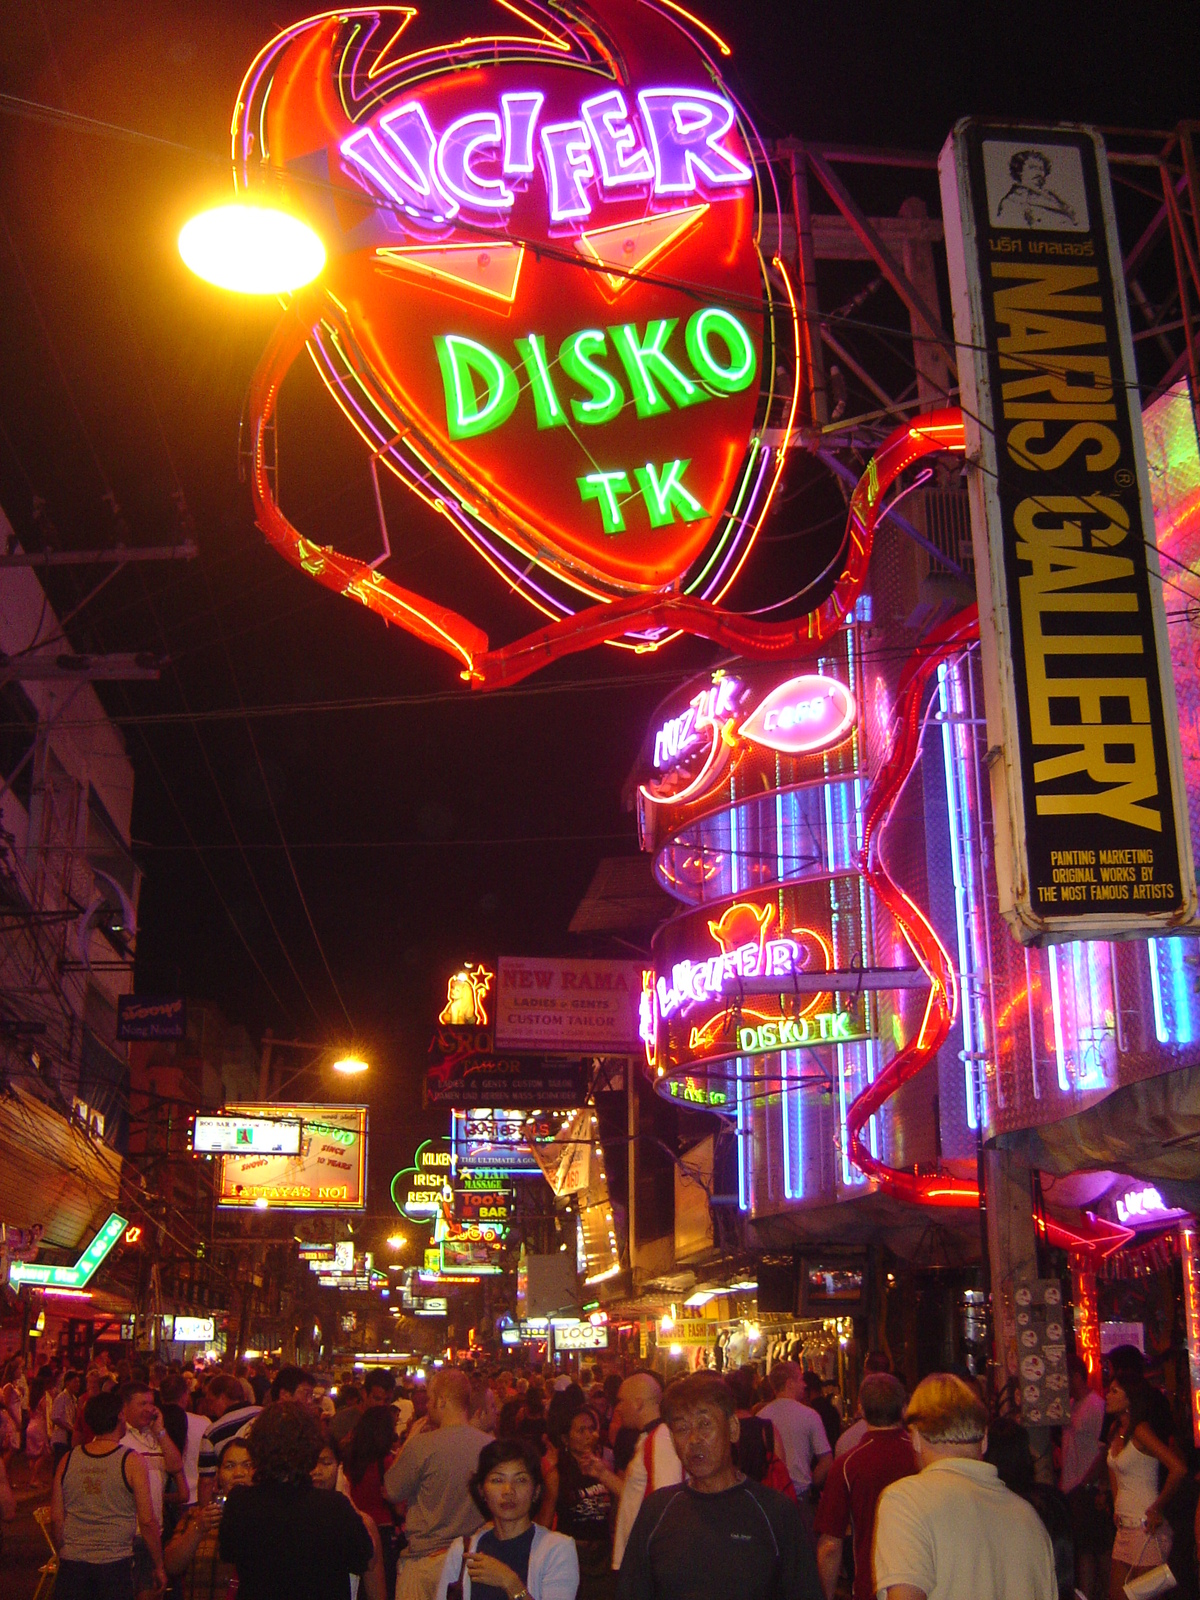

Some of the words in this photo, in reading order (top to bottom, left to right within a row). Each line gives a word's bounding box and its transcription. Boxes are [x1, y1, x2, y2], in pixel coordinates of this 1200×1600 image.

[433, 308, 756, 441] DISKO
[990, 262, 1121, 472] NARIS
[576, 458, 712, 534] TK
[1013, 495, 1162, 833] GALLERY
[1050, 850, 1096, 866] PAINTING
[1099, 849, 1154, 864] MARKETING
[1052, 868, 1097, 883] ORIGINAL
[1101, 867, 1136, 882] WORKS
[1141, 867, 1154, 881] BY
[1037, 886, 1058, 902] THE
[1061, 886, 1087, 900] MOST
[1090, 885, 1129, 900] FAMOUS
[1133, 884, 1174, 899] ARTISTS
[503, 969, 554, 990] NEW
[561, 970, 629, 992] RAMA
[514, 998, 556, 1008] LADIES
[571, 999, 609, 1009] GENTS
[508, 1013, 562, 1025] CUSTOM
[566, 1015, 614, 1026] TAILOR
[740, 1017, 809, 1051] DISKO
[815, 1012, 849, 1039] TK
[482, 1080, 507, 1088] GENTS
[512, 1080, 543, 1088] CUSTOM
[320, 1144, 346, 1156] SINCE
[413, 1174, 447, 1187] IRISH
[464, 1179, 503, 1189] MASSAGE
[479, 1207, 507, 1217] BAR
